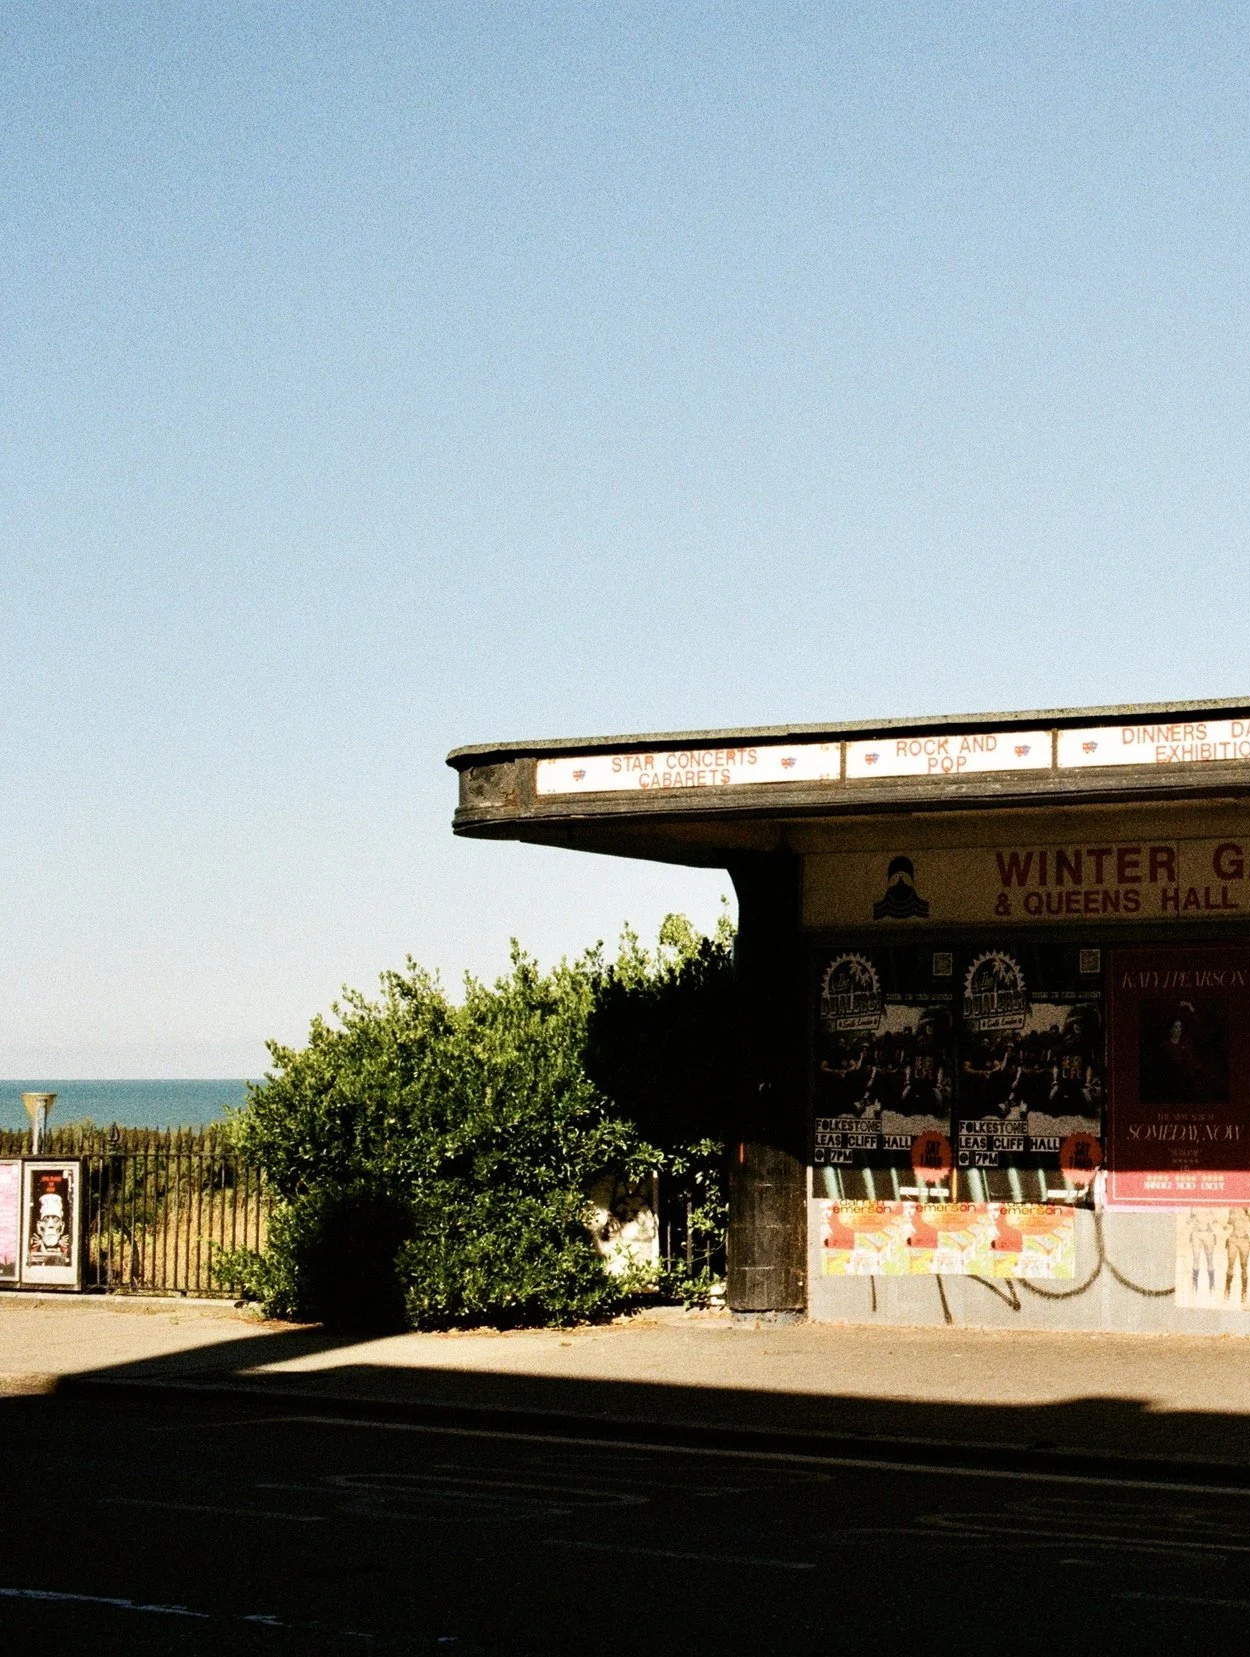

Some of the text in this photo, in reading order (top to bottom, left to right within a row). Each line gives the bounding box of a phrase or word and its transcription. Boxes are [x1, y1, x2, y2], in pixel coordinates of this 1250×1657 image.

[1122, 723, 1208, 745] DINNERS
[896, 735, 998, 757] ROCK AND
[611, 748, 758, 773] STAR CONCERTS
[927, 755, 968, 774] POP
[638, 769, 731, 789] CABARETS
[995, 845, 1177, 887] WINTER
[995, 885, 1239, 916] & QUEENS HALL
[1172, 969, 1248, 988] PEARSON
[816, 1119, 882, 1132] FOLKESTONE
[959, 1121, 1028, 1134] FOLKESTONE
[1202, 1123, 1246, 1141] NOW
[816, 1135, 911, 1149] LEAS CLIFF HALL
[959, 1137, 1060, 1150] LEAS CLIFF HALL
[815, 1149, 853, 1161] @ 7PM
[959, 1152, 998, 1164] @ 7PM
[832, 1205, 892, 1214] emerson
[915, 1204, 977, 1213] emerson
[1000, 1206, 1063, 1216] emerson
